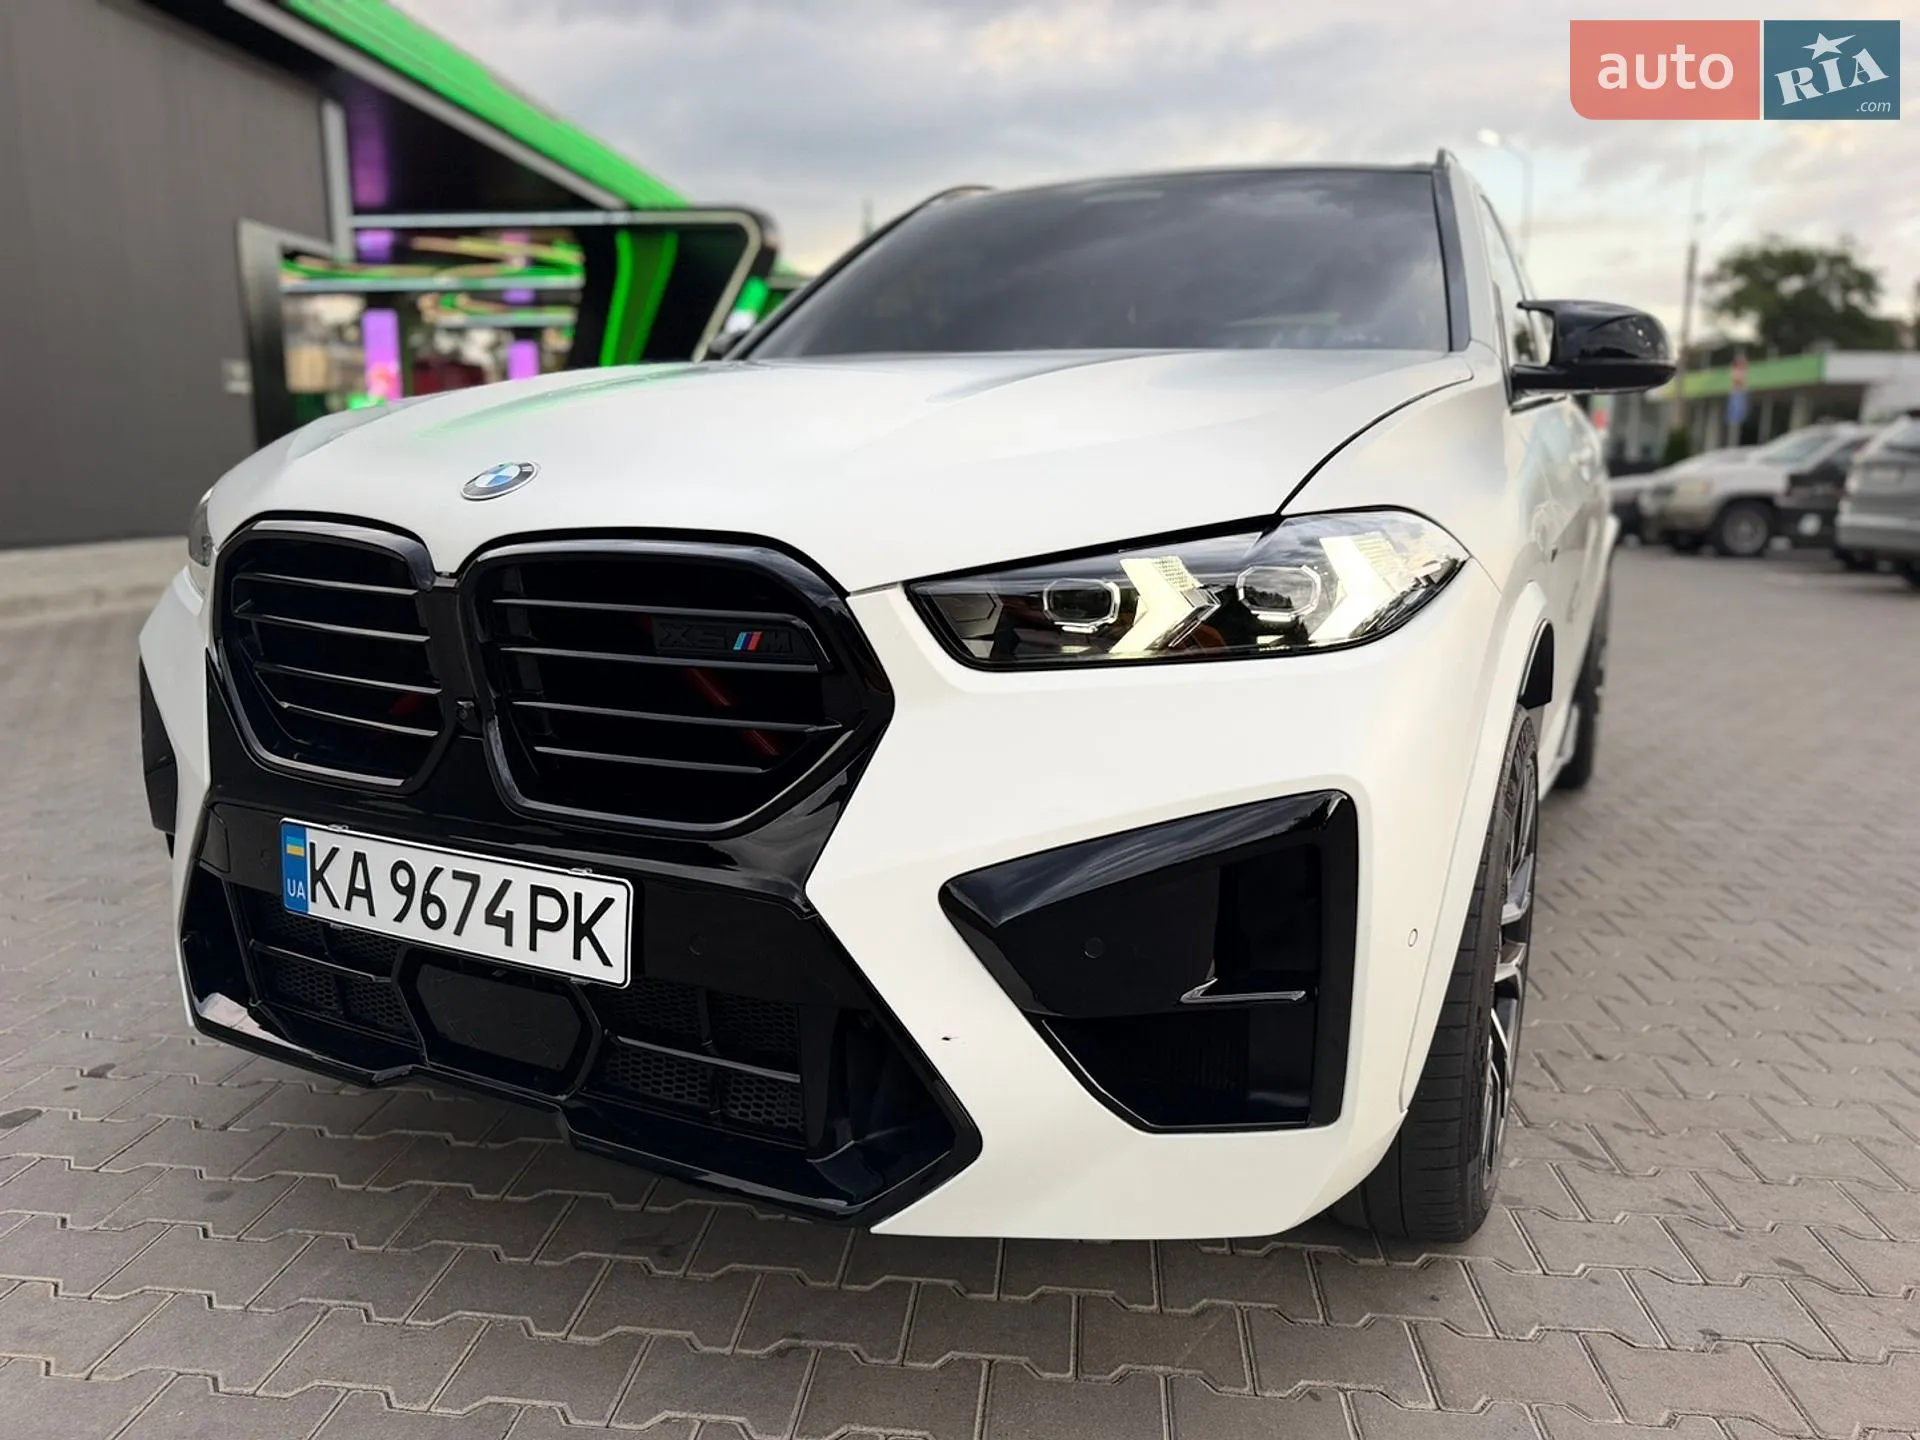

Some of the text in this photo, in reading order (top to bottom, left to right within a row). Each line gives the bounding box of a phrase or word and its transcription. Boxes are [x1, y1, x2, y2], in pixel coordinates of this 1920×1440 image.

[287, 878, 306, 900] UA
[308, 841, 616, 968] KA 9674 PK
